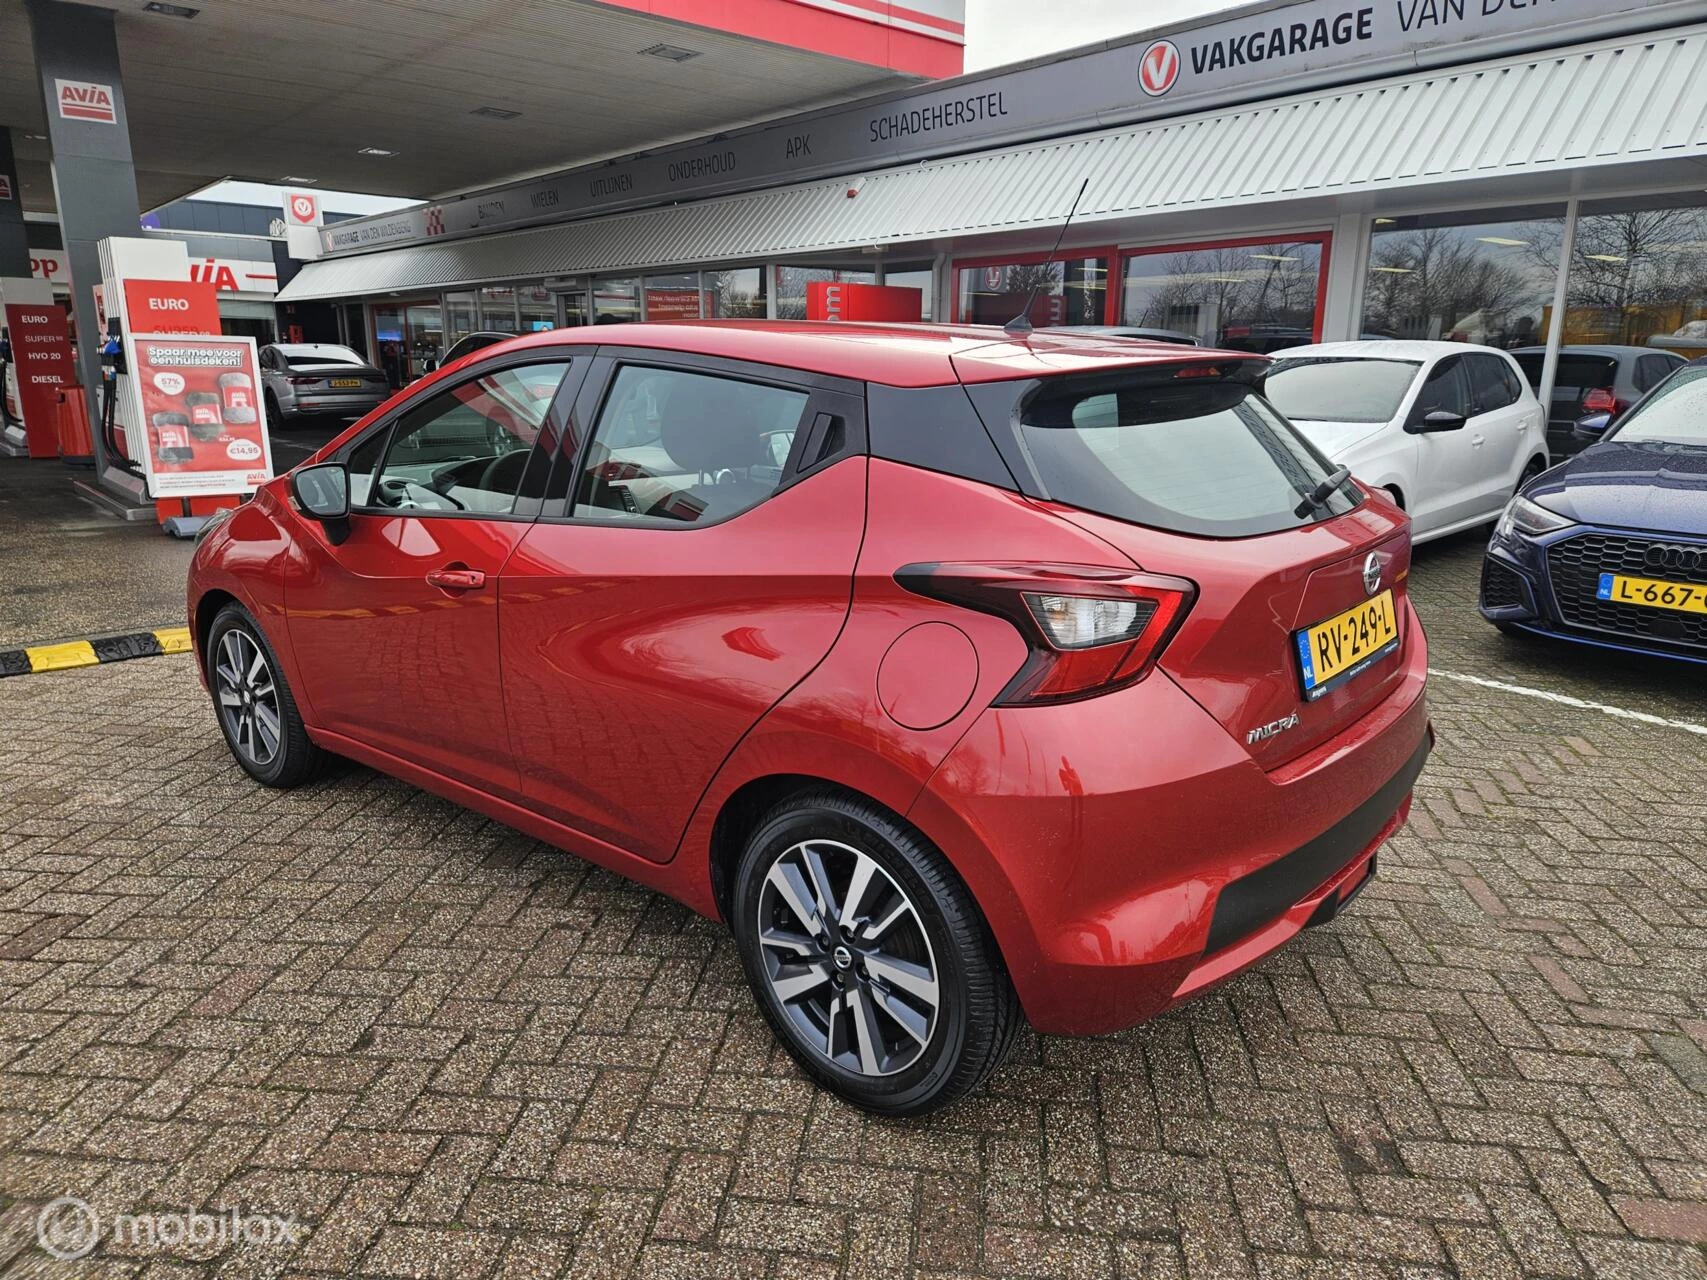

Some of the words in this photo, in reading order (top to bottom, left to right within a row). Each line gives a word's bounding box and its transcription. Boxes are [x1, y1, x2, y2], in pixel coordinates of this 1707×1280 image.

[1191, 8, 1373, 75] VAKGARAGE
[870, 91, 1008, 143] SCHADEHERSTEL
[785, 134, 812, 159] APK
[668, 151, 736, 182] ONDERHOUD
[530, 191, 560, 208] WIELEN
[149, 297, 190, 311] EURO
[21, 315, 48, 324] EURO
[25, 334, 55, 344] SUPER
[28, 352, 48, 360] HVO
[50, 352, 61, 360] 20
[149, 346, 187, 358] Spaar
[188, 349, 214, 357] mee
[214, 350, 242, 358] voor
[150, 356, 173, 364] een
[175, 356, 241, 366] huisdeken!
[32, 375, 64, 384] DIESEL
[1317, 600, 1391, 672] RV-249-L
[1247, 714, 1299, 744] MICRA
